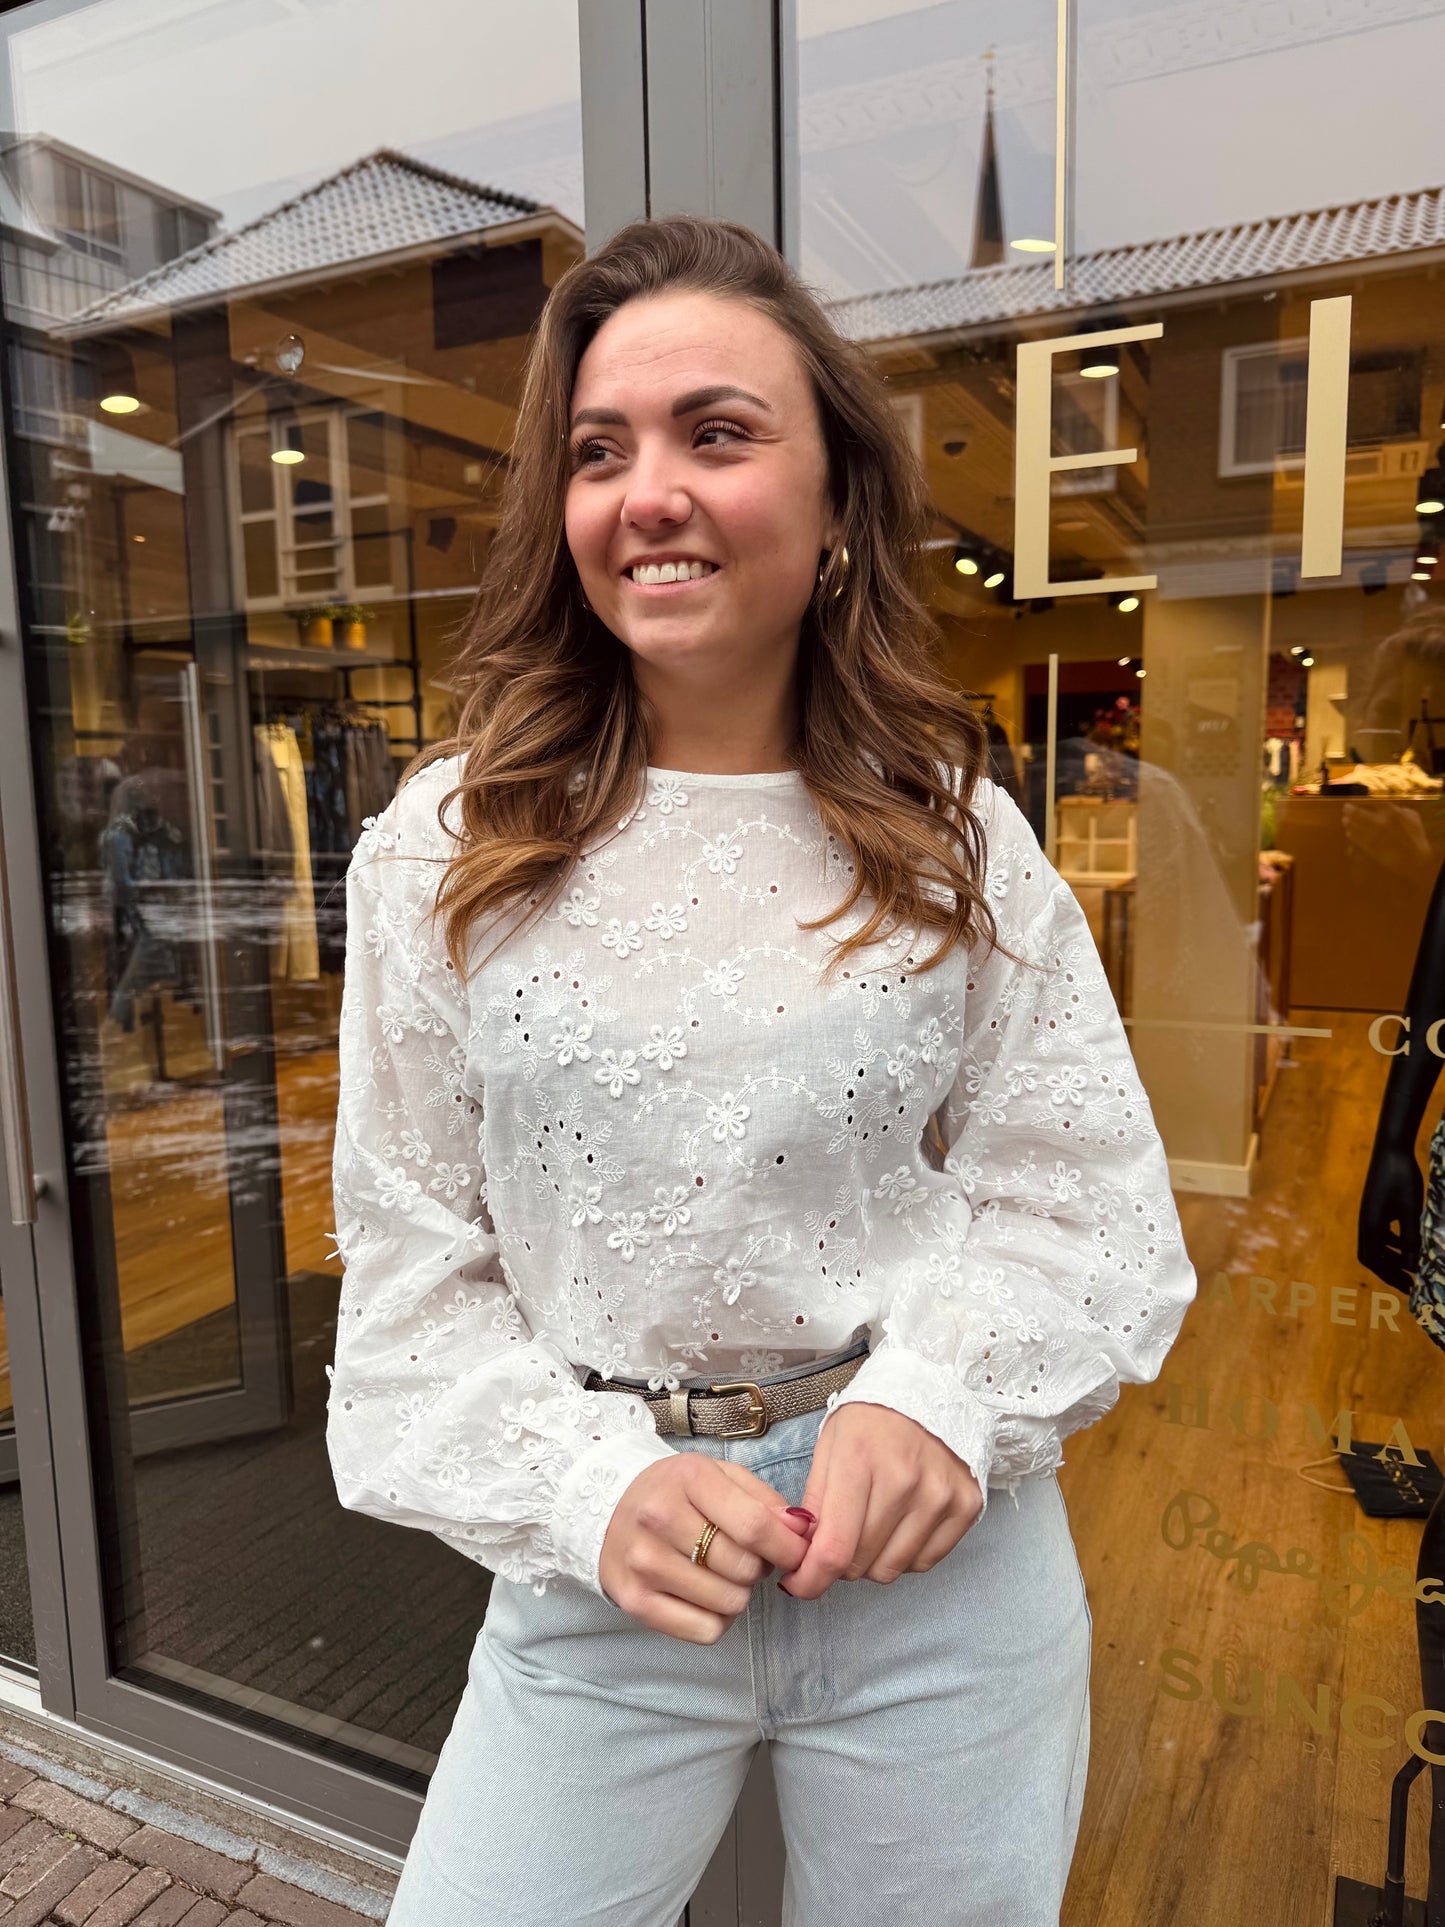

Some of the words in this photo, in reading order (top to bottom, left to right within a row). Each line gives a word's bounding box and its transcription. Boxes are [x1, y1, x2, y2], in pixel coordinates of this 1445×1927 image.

[1164, 1383, 1445, 1467] HOMA
[1161, 1489, 1318, 1594] Pepe
[1302, 1741, 1382, 1777] PARS
